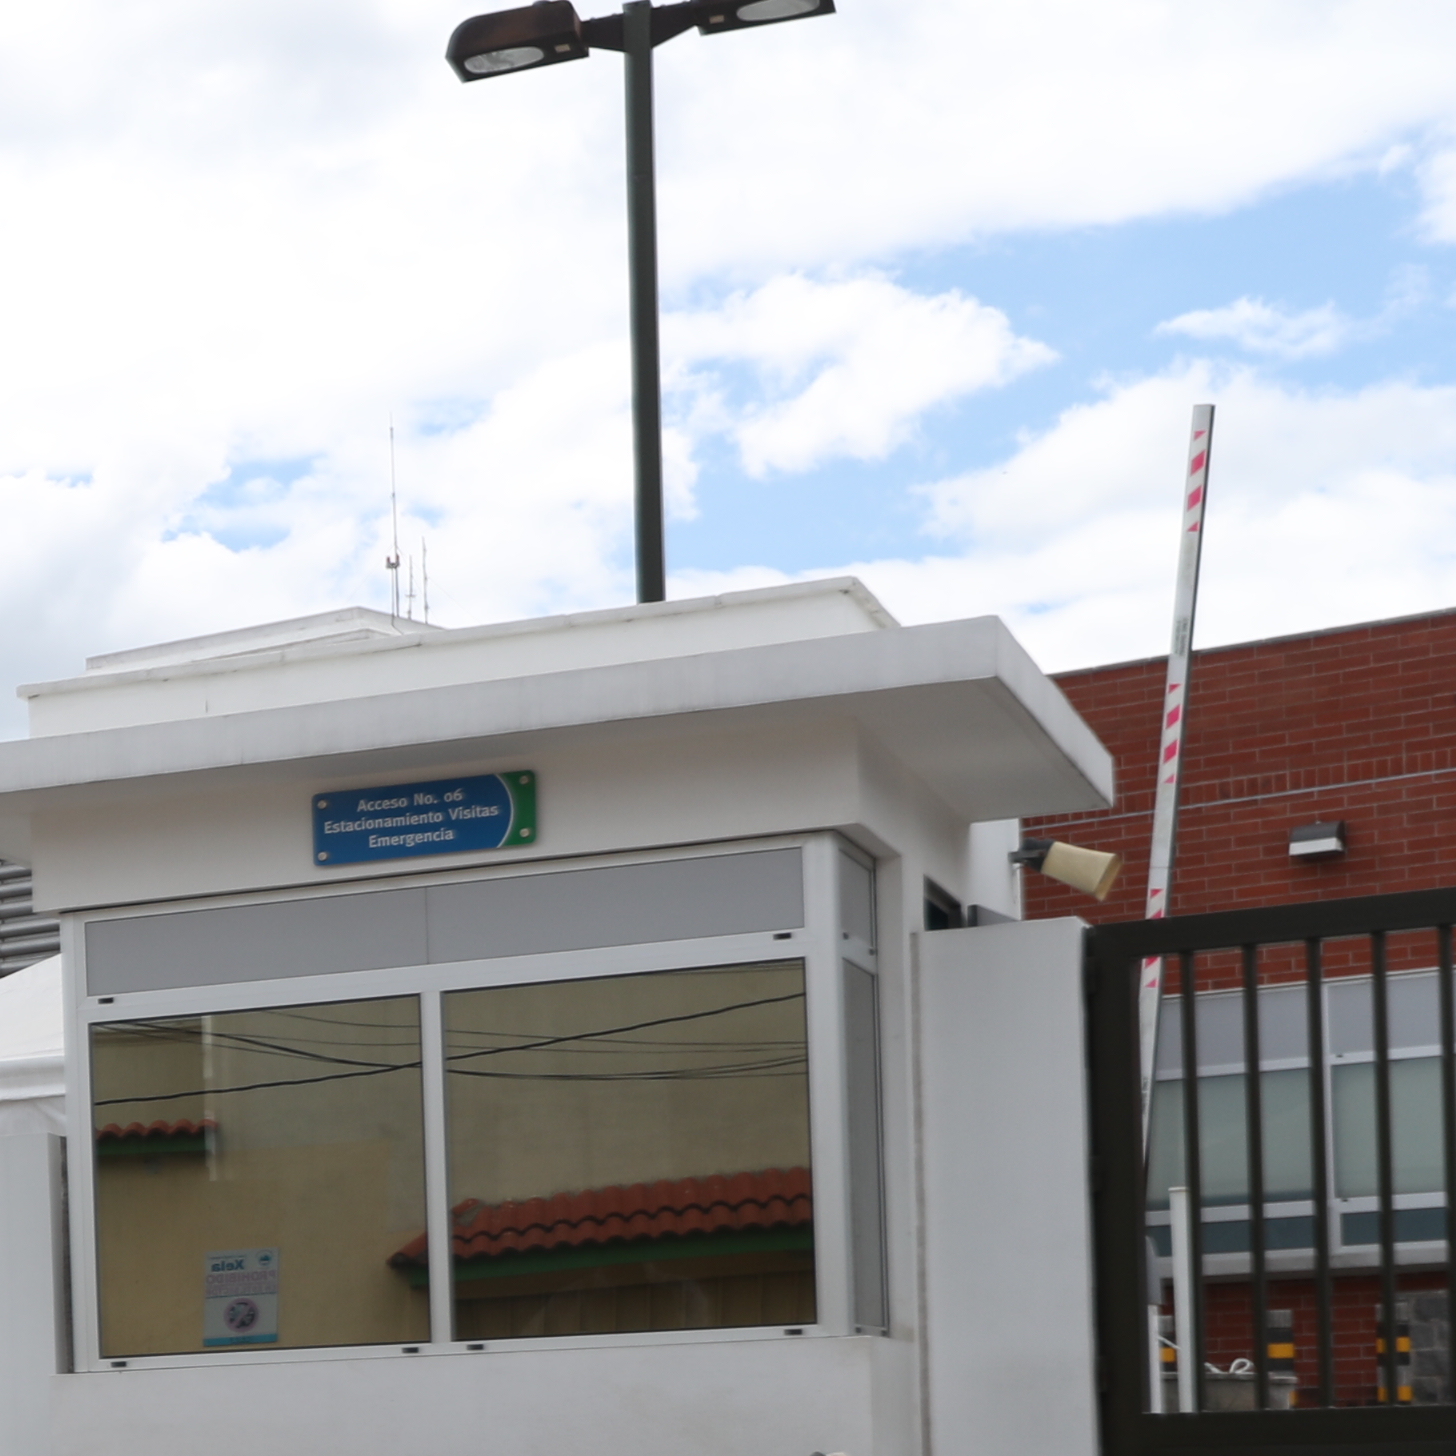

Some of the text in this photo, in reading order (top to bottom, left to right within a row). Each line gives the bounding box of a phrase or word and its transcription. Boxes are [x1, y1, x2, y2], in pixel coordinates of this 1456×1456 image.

[356, 797, 408, 812] Acceso
[413, 792, 438, 805] No.
[324, 804, 500, 834] Estacionamiento Visitas
[368, 828, 455, 848] Emergencia
